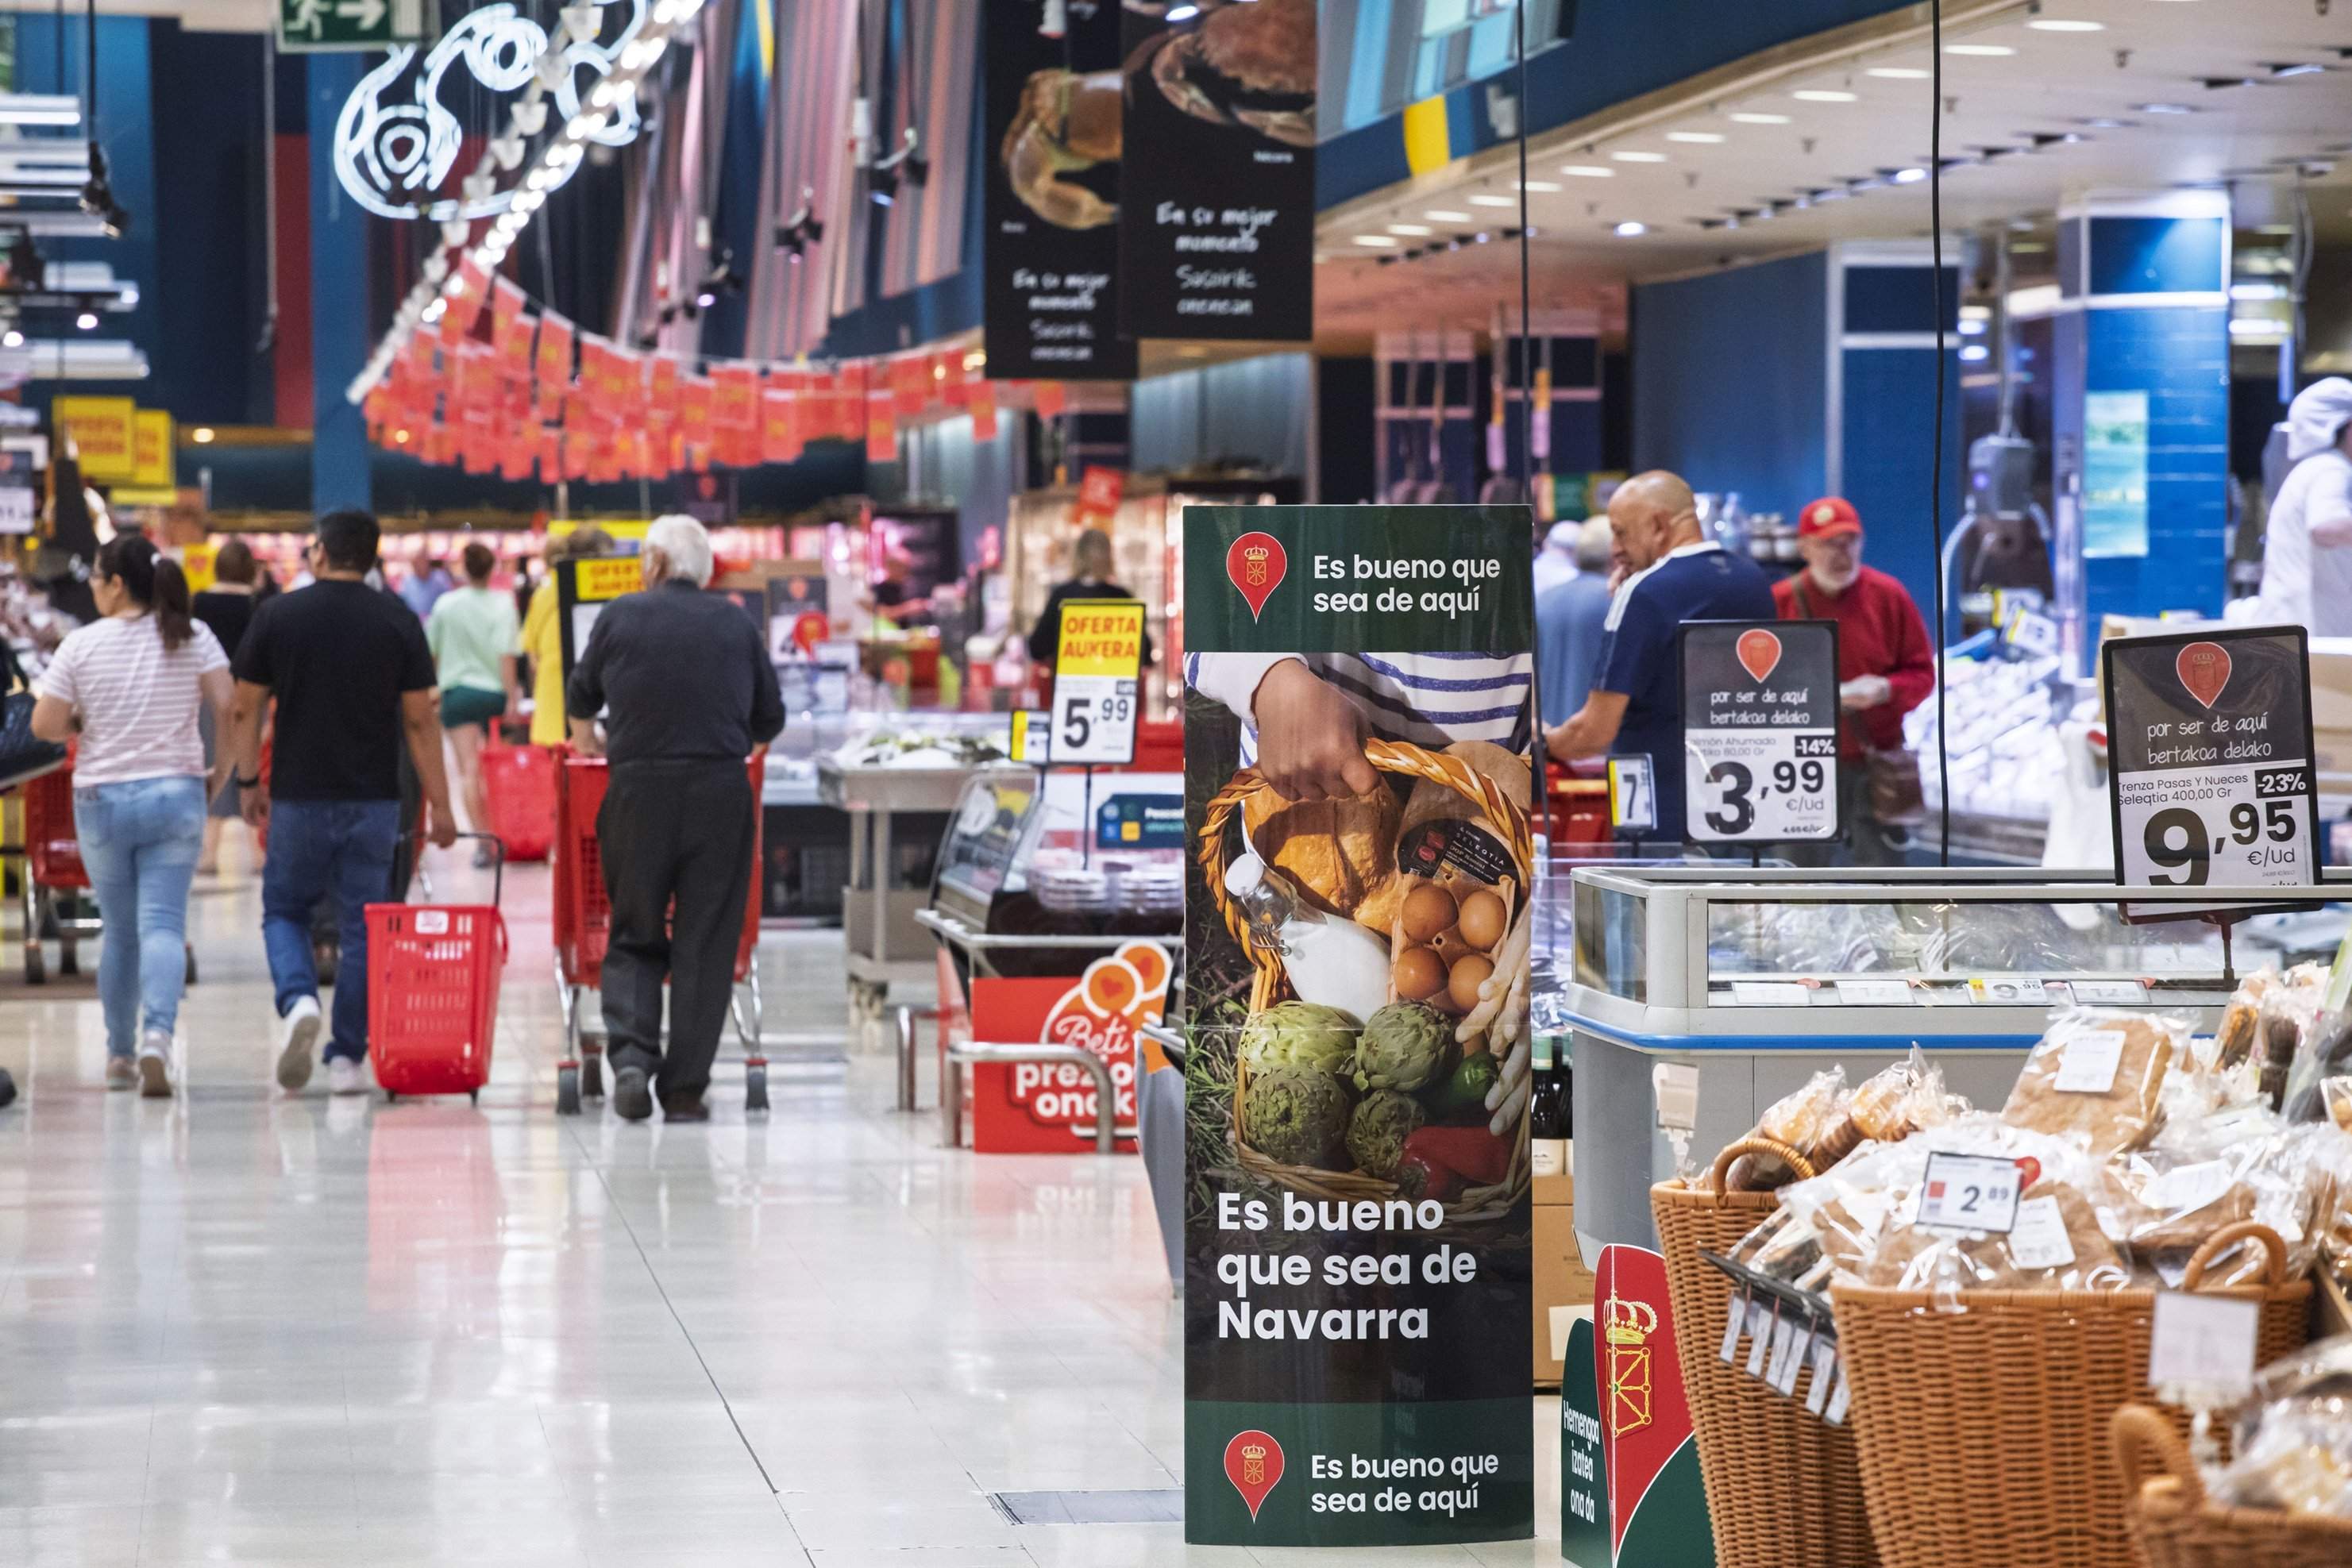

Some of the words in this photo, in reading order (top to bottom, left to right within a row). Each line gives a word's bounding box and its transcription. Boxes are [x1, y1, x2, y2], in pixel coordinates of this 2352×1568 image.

[1314, 555, 1345, 579] Es
[1354, 554, 1445, 579] bueno
[1452, 558, 1500, 586] que
[1314, 592, 1367, 612] sea
[1376, 588, 1413, 612] de
[1420, 585, 1480, 619] aquí
[1065, 617, 1137, 634] OFERTA
[1062, 641, 1136, 658] AUKERA
[1710, 692, 1731, 706] por
[1736, 692, 1756, 703] ser
[1761, 688, 1777, 703] de
[1780, 688, 1809, 706] aquí
[1710, 711, 1767, 725] bertakoa
[1770, 709, 1810, 725] delako
[2147, 721, 2171, 742] por
[2178, 720, 2204, 736] ser
[2211, 715, 2230, 734] de
[2235, 711, 2268, 734] aquí
[1687, 737, 1723, 746] almón
[1725, 737, 1777, 746] Ahumado
[1795, 739, 1835, 754] -14%
[2148, 747, 2217, 765] bertakoa
[2223, 741, 2272, 760] delako
[1623, 774, 1637, 819] 7
[2157, 778, 2192, 790] Pasas
[2195, 776, 2203, 786] Y
[2205, 774, 2248, 785] Nueces
[2258, 772, 2306, 793] -23%
[1787, 796, 1824, 813] €/Ud
[2118, 792, 2169, 807] Seleqtia
[2172, 788, 2214, 802] 400,00
[2217, 788, 2232, 799] Gr
[2247, 846, 2295, 868] €/Ud
[1055, 1015, 1130, 1054] Beti
[1016, 1057, 1133, 1098] prezo
[1218, 1192, 1269, 1231] Es
[1283, 1192, 1444, 1231] bueno
[1217, 1254, 1311, 1297] que
[1323, 1254, 1410, 1285] sea
[1421, 1244, 1477, 1284] de
[1218, 1300, 1429, 1339] Navarra
[1563, 1400, 1599, 1451] Hemengoa
[1312, 1454, 1343, 1478] Es
[1351, 1454, 1444, 1478] bueno
[1451, 1454, 1499, 1483] que
[1571, 1439, 1593, 1482] izatea
[1311, 1492, 1366, 1512] sea
[1374, 1487, 1411, 1512] de
[1418, 1481, 1479, 1518] aquí
[1571, 1489, 1584, 1518] ona
[1585, 1490, 1594, 1524] da
